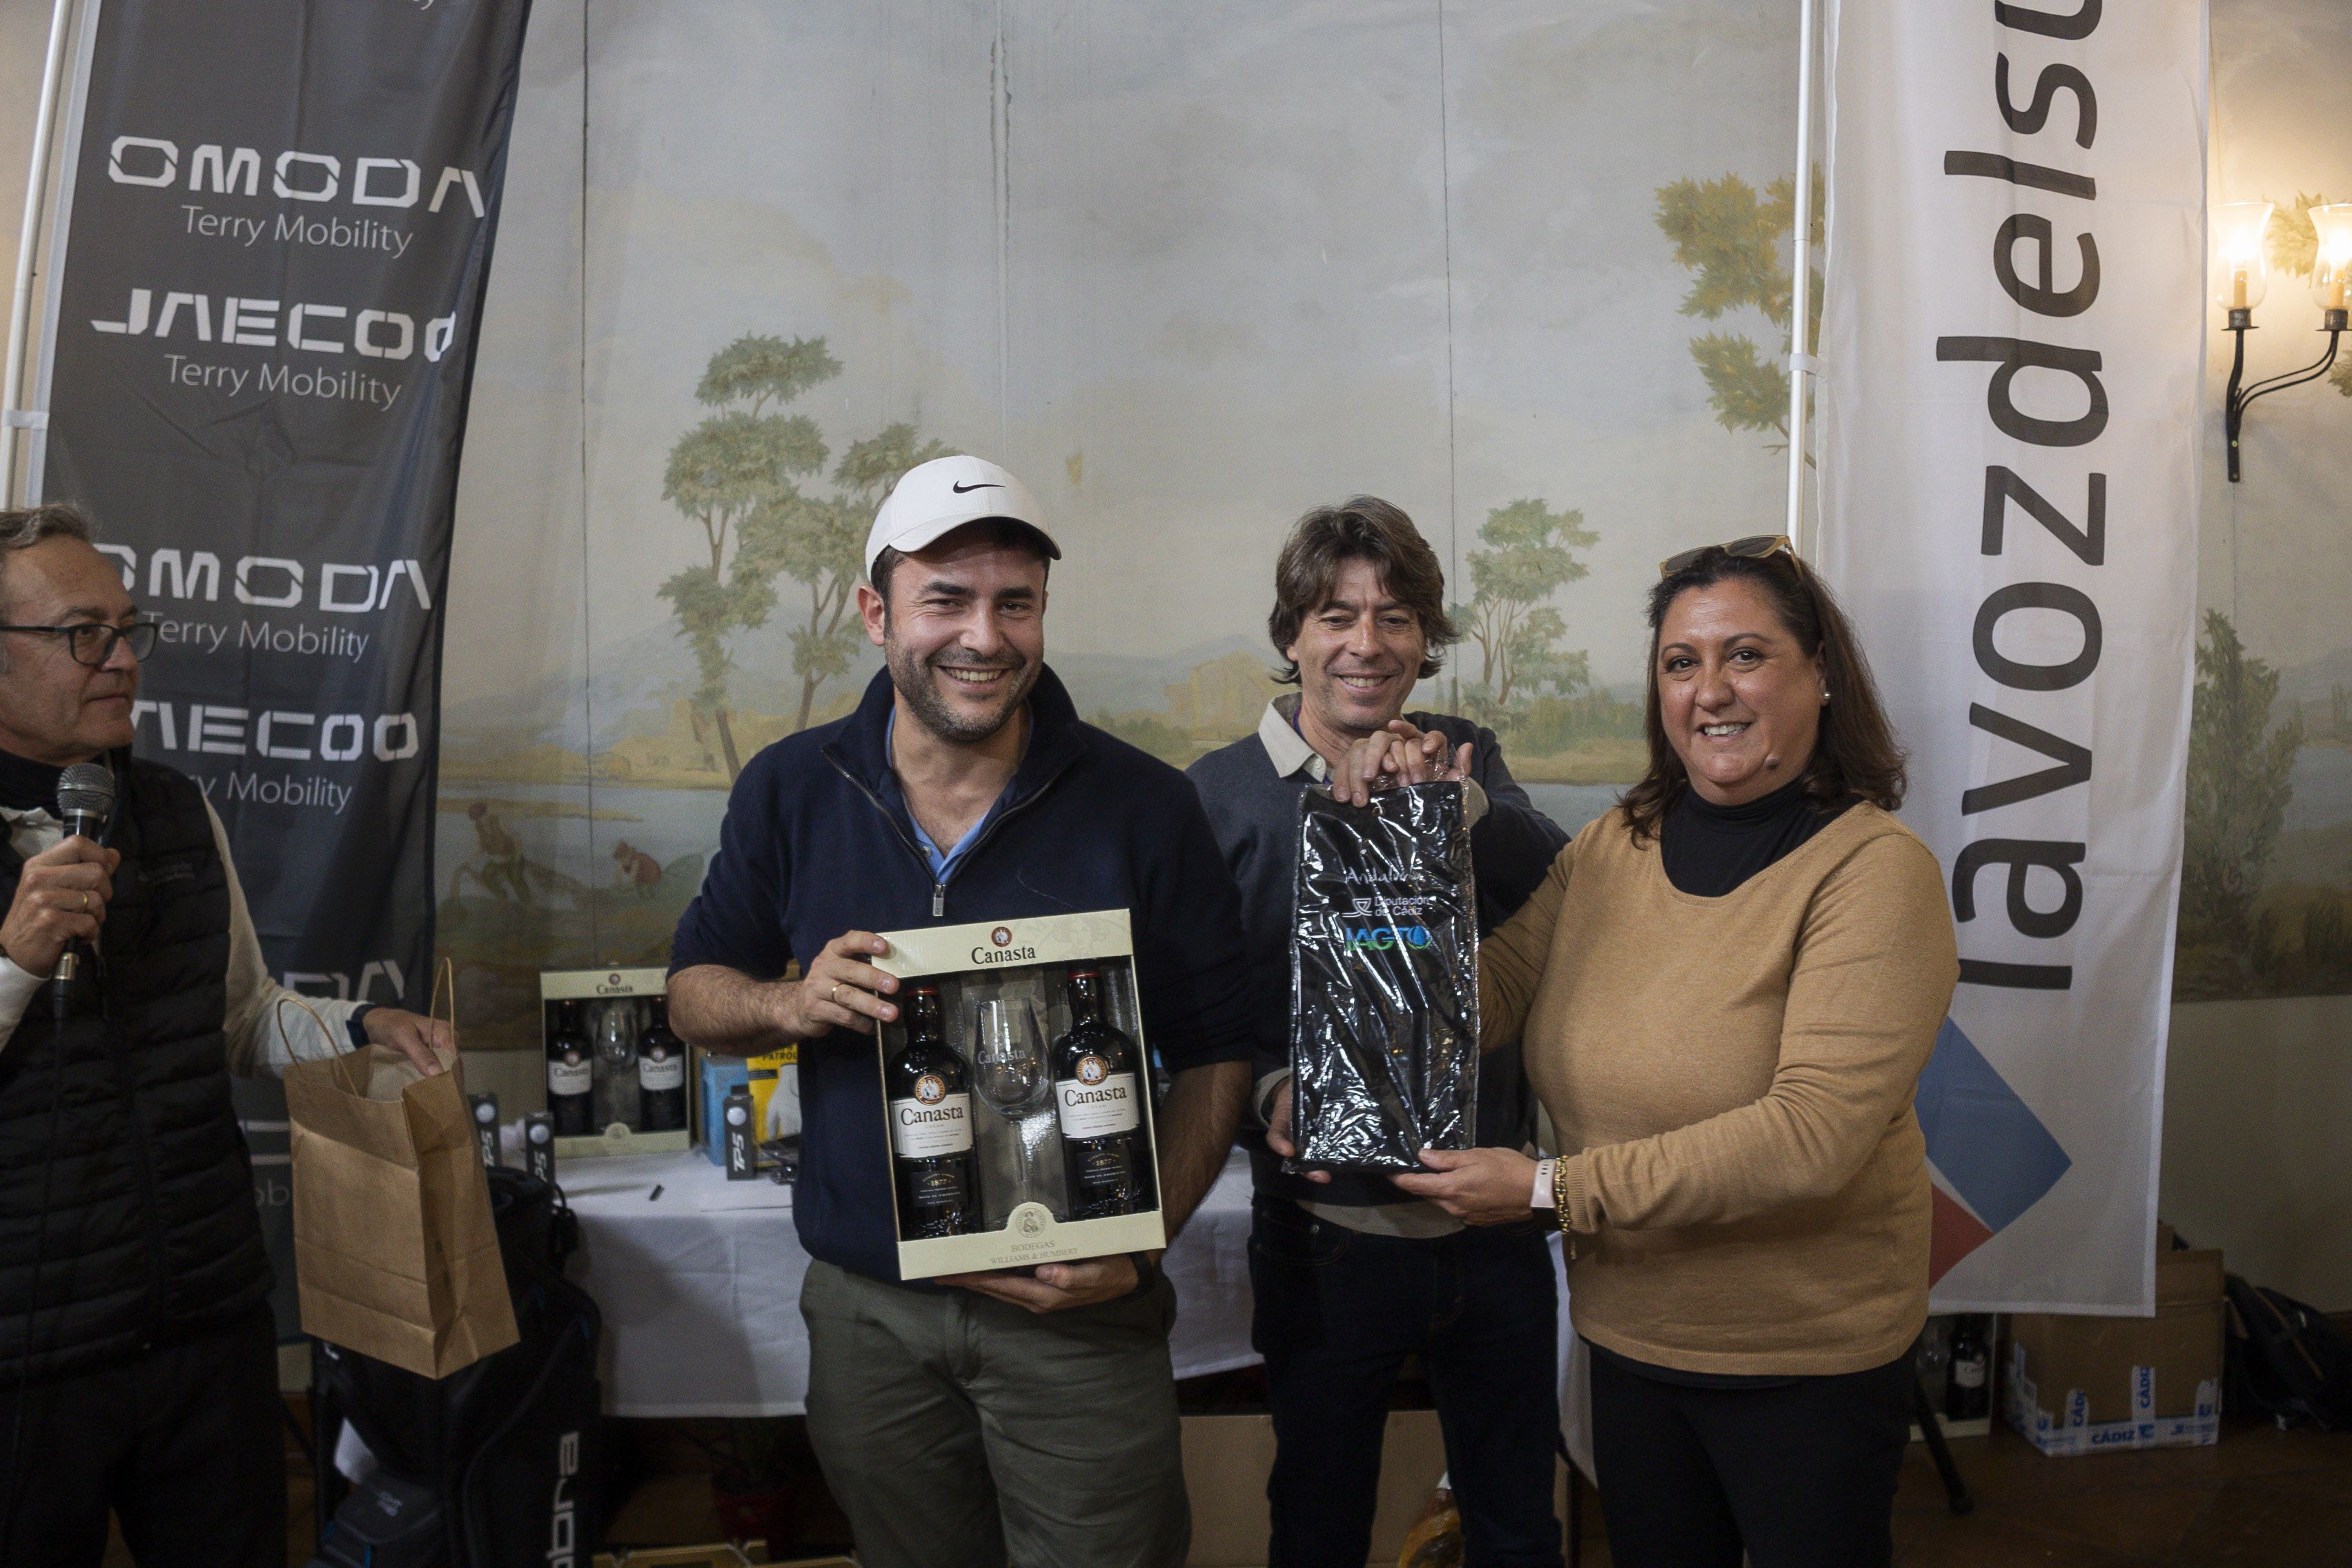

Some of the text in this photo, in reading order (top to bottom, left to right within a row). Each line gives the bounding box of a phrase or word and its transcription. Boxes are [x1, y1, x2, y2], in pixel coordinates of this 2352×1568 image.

[108, 136, 485, 217] OMODA
[181, 205, 414, 259] Terry Mobility
[164, 353, 402, 411] Terry Mobility
[239, 620, 370, 663] Mobility
[131, 700, 420, 762] AECOO
[227, 771, 353, 813] Mobility
[972, 946, 1036, 965] Canasta
[978, 1048, 1027, 1065] Canasta
[1064, 1086, 1127, 1107] Canasta
[900, 1106, 964, 1126] Canasta
[533, 1150, 548, 1183] PS
[990, 1254, 1031, 1265] WILLIAMS
[1040, 1248, 1078, 1260] HUMBERT
[1011, 1239, 1056, 1253] BODEGAS
